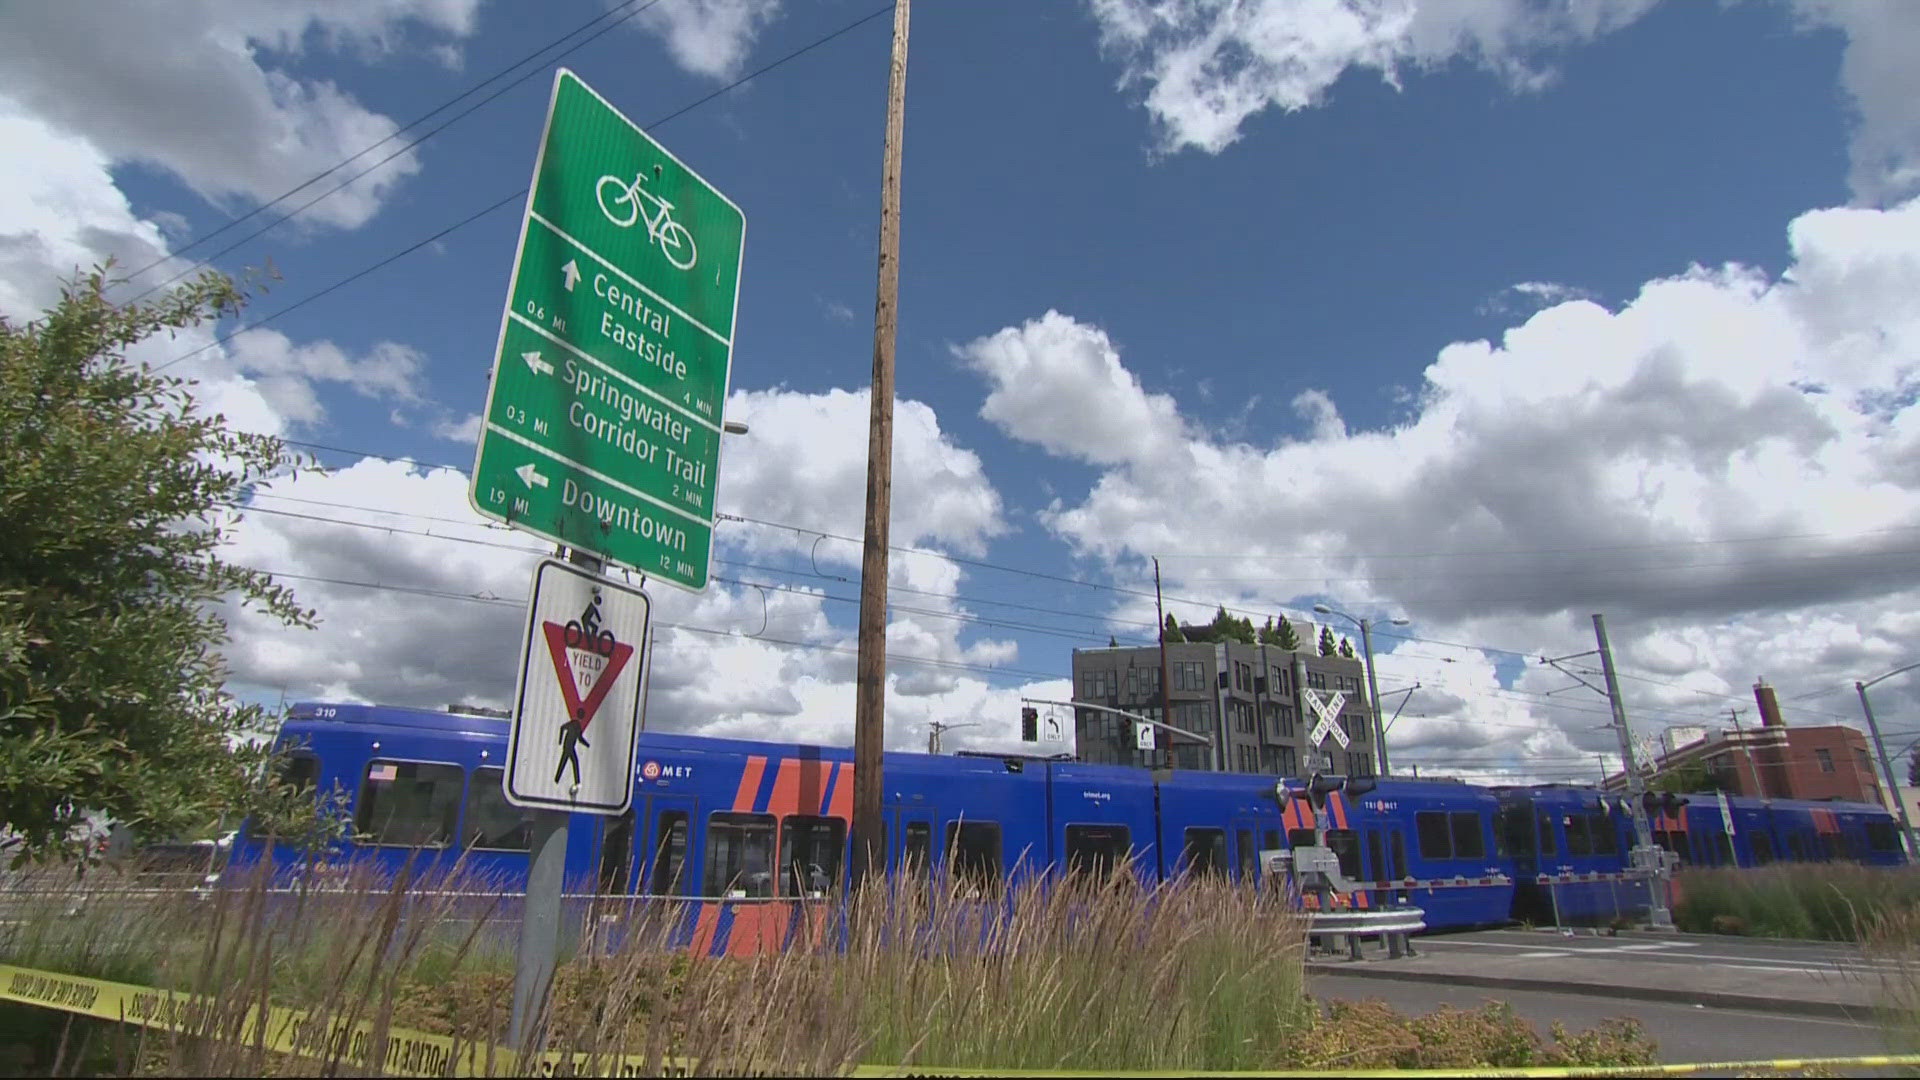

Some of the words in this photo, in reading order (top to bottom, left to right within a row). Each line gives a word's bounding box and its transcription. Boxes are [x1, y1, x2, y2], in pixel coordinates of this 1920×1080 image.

[527, 300, 545, 320] 0.6
[593, 273, 670, 338] Central
[601, 311, 687, 381] Eastside
[562, 359, 692, 445] Springwater
[683, 392, 690, 405] 4
[506, 404, 526, 425] 0.3
[569, 401, 659, 464] Corridor
[665, 448, 706, 489] Trail
[489, 486, 506, 505] 1.9
[672, 484, 680, 497] 2
[561, 478, 687, 553] Downtown
[660, 553, 671, 570] 12
[573, 651, 602, 672] YIELD
[579, 671, 592, 687] TO
[315, 707, 336, 718] 310
[1313, 694, 1344, 743] CROSSING
[662, 766, 693, 778] MET
[1083, 790, 1111, 801] trimet.org
[403, 1039, 449, 1077] POLICE
